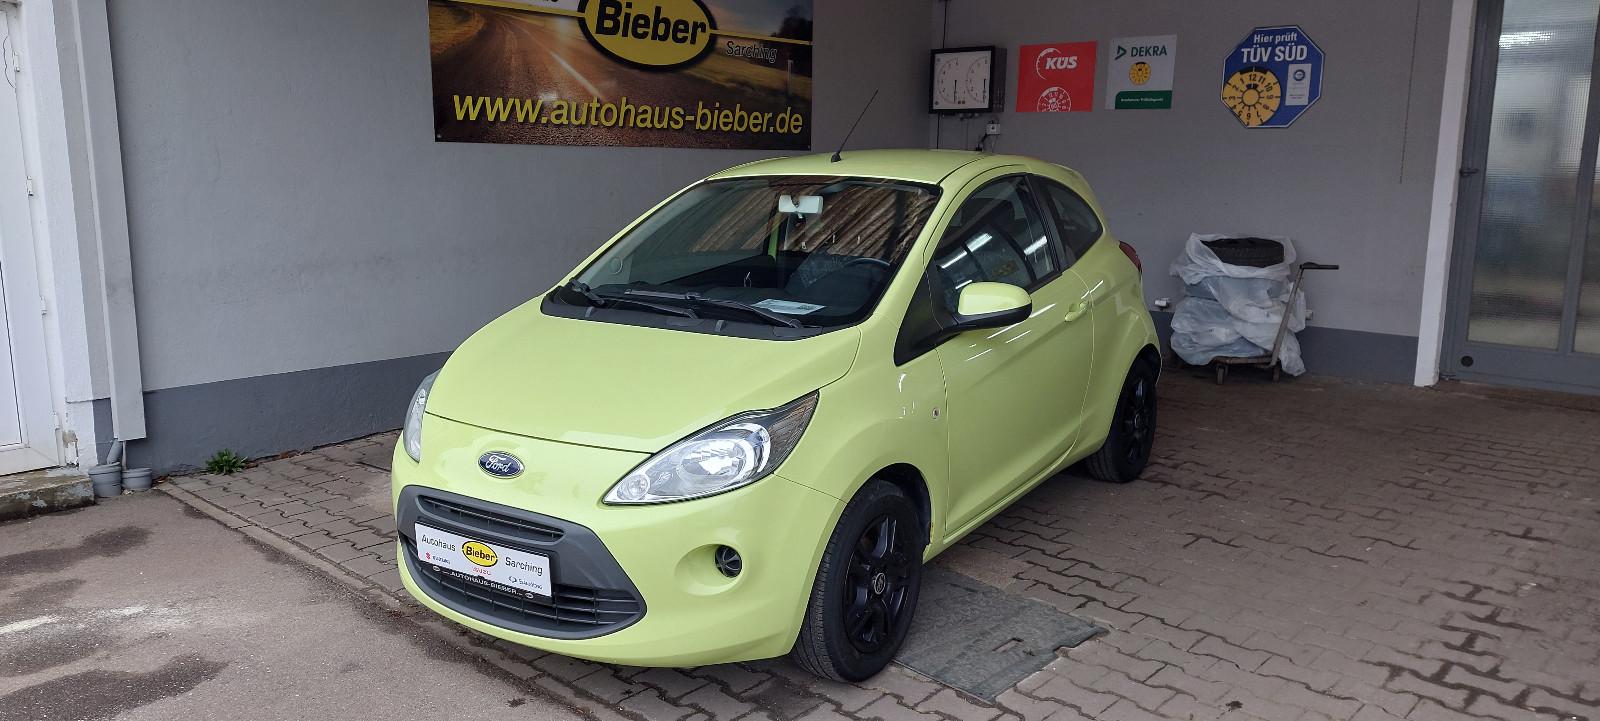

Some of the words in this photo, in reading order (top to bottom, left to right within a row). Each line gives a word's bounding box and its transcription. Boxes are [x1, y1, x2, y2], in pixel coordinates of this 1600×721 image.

[595, 0, 707, 45] Bieber
[1253, 34, 1273, 43] Hier
[1275, 31, 1298, 44] prüft
[725, 40, 777, 64] Sarching
[1130, 45, 1168, 58] DEKRA
[1241, 45, 1272, 63] TÜV
[1274, 42, 1308, 62] SÜD
[1248, 74, 1257, 82] 12
[1258, 76, 1266, 84] 11
[453, 94, 803, 134] www.autohaus-bieber.de
[485, 454, 512, 473] Ford
[421, 534, 456, 552] Autohaus
[465, 545, 496, 562] Bieber
[505, 556, 543, 576] Sarching
